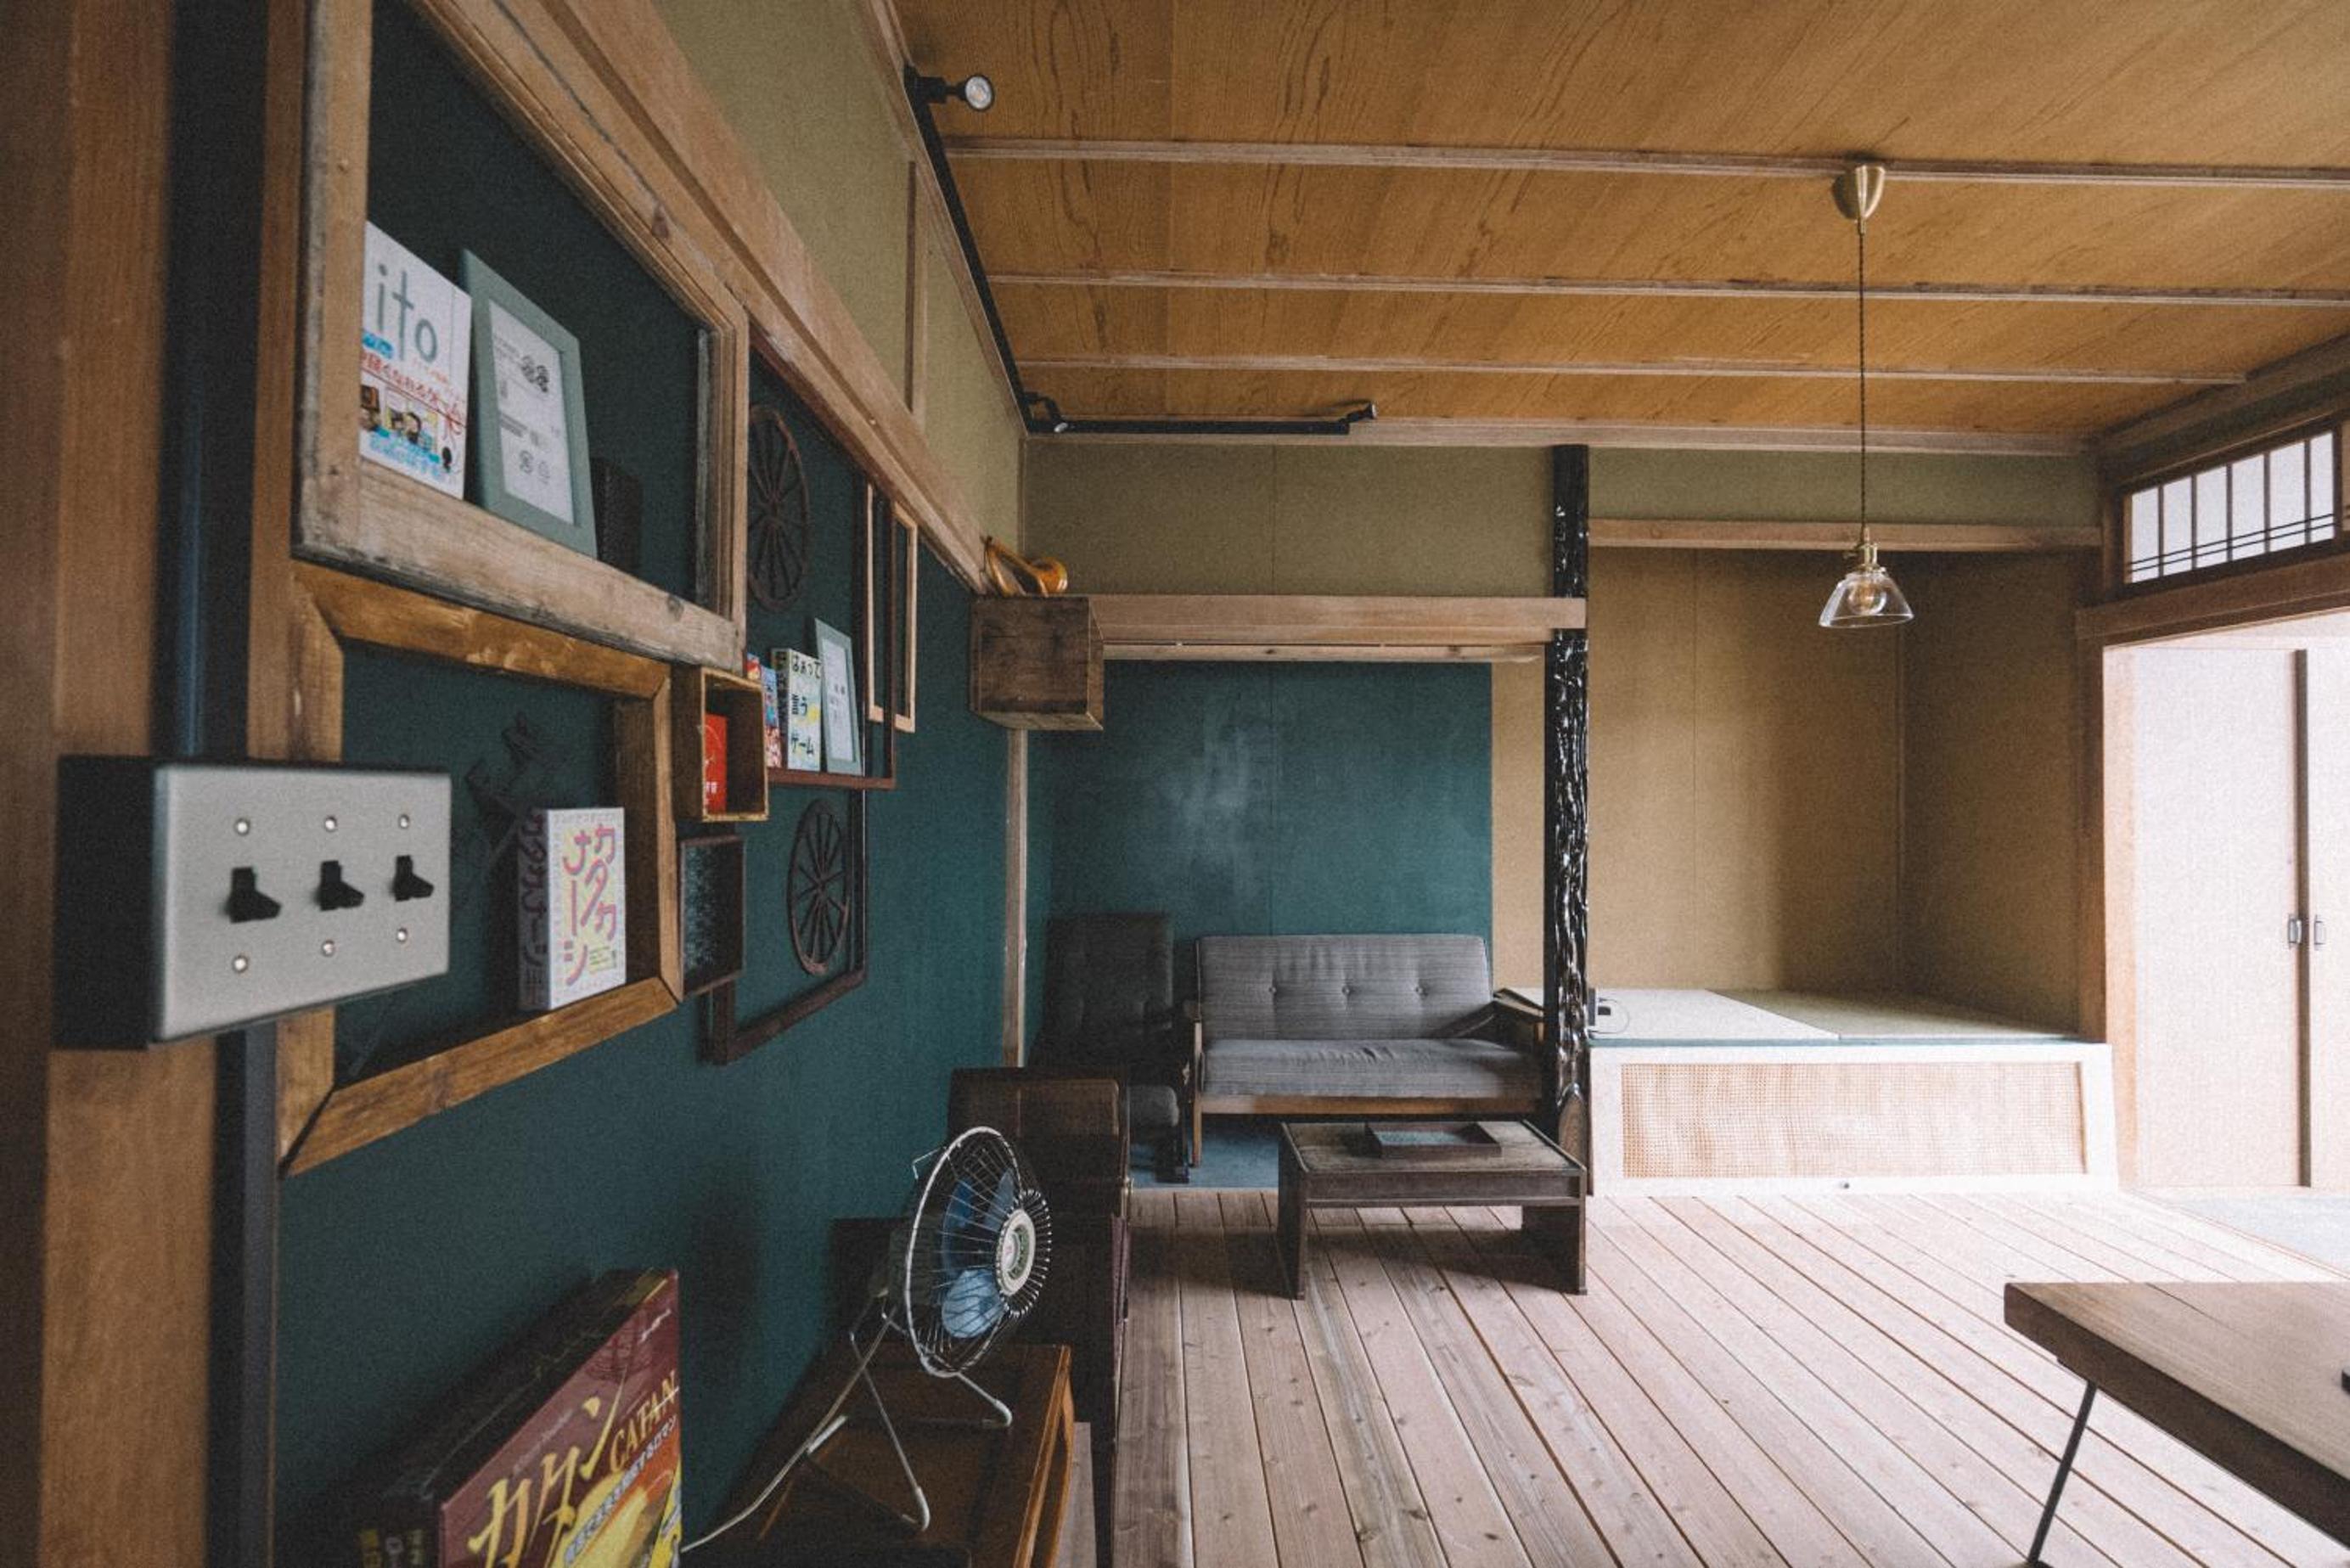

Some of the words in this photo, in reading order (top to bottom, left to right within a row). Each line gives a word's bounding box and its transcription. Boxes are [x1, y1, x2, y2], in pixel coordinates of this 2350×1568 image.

[378, 263, 438, 363] ito
[466, 1363, 628, 1568] カタン
